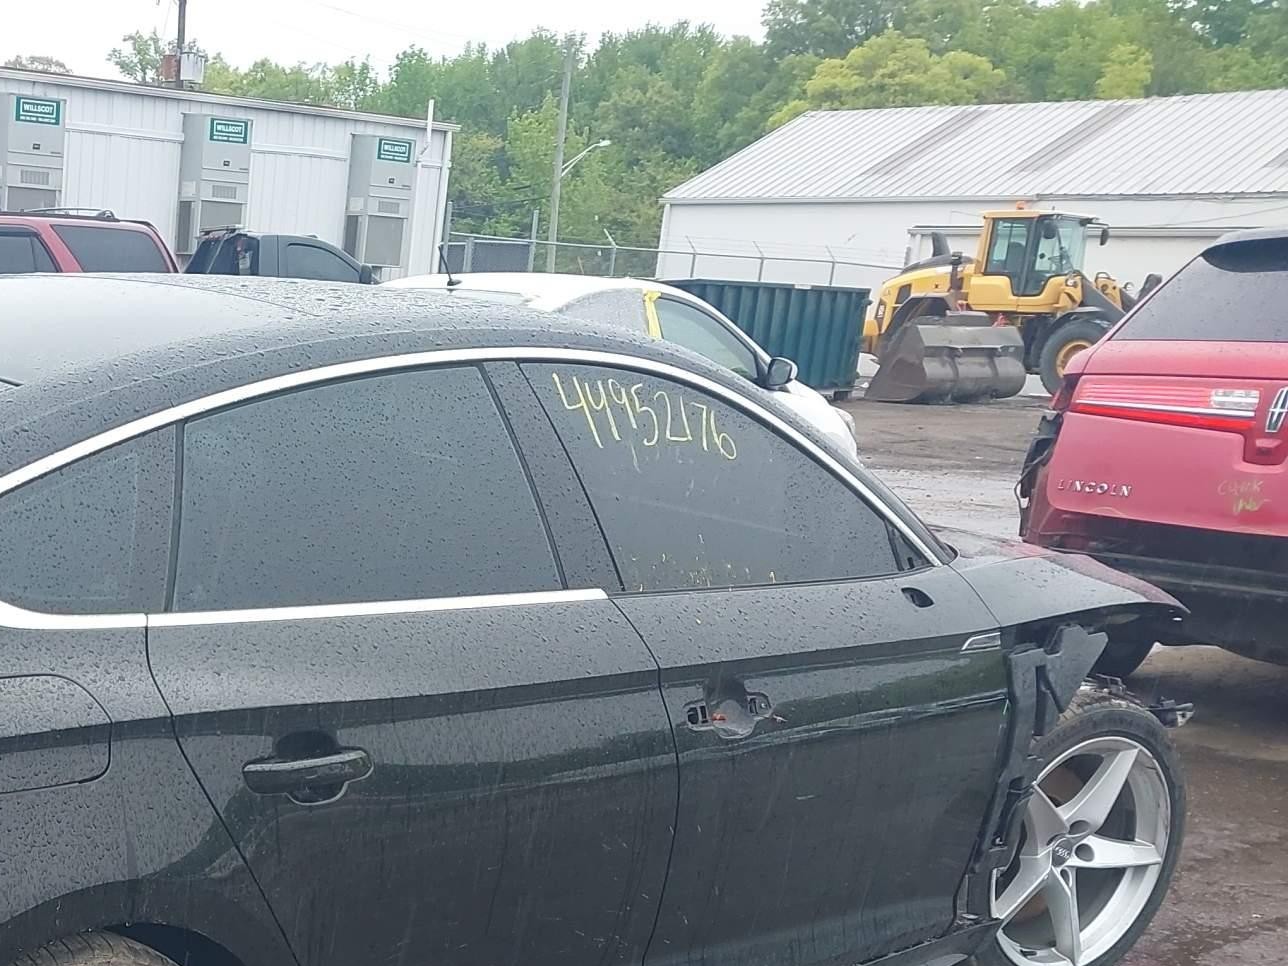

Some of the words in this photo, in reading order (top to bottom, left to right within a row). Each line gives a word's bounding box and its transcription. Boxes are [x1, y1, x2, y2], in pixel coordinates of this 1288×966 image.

[23, 103, 53, 113] WILLSCOT
[552, 372, 737, 460] 44952176
[1057, 479, 1132, 497] LINCOLN
